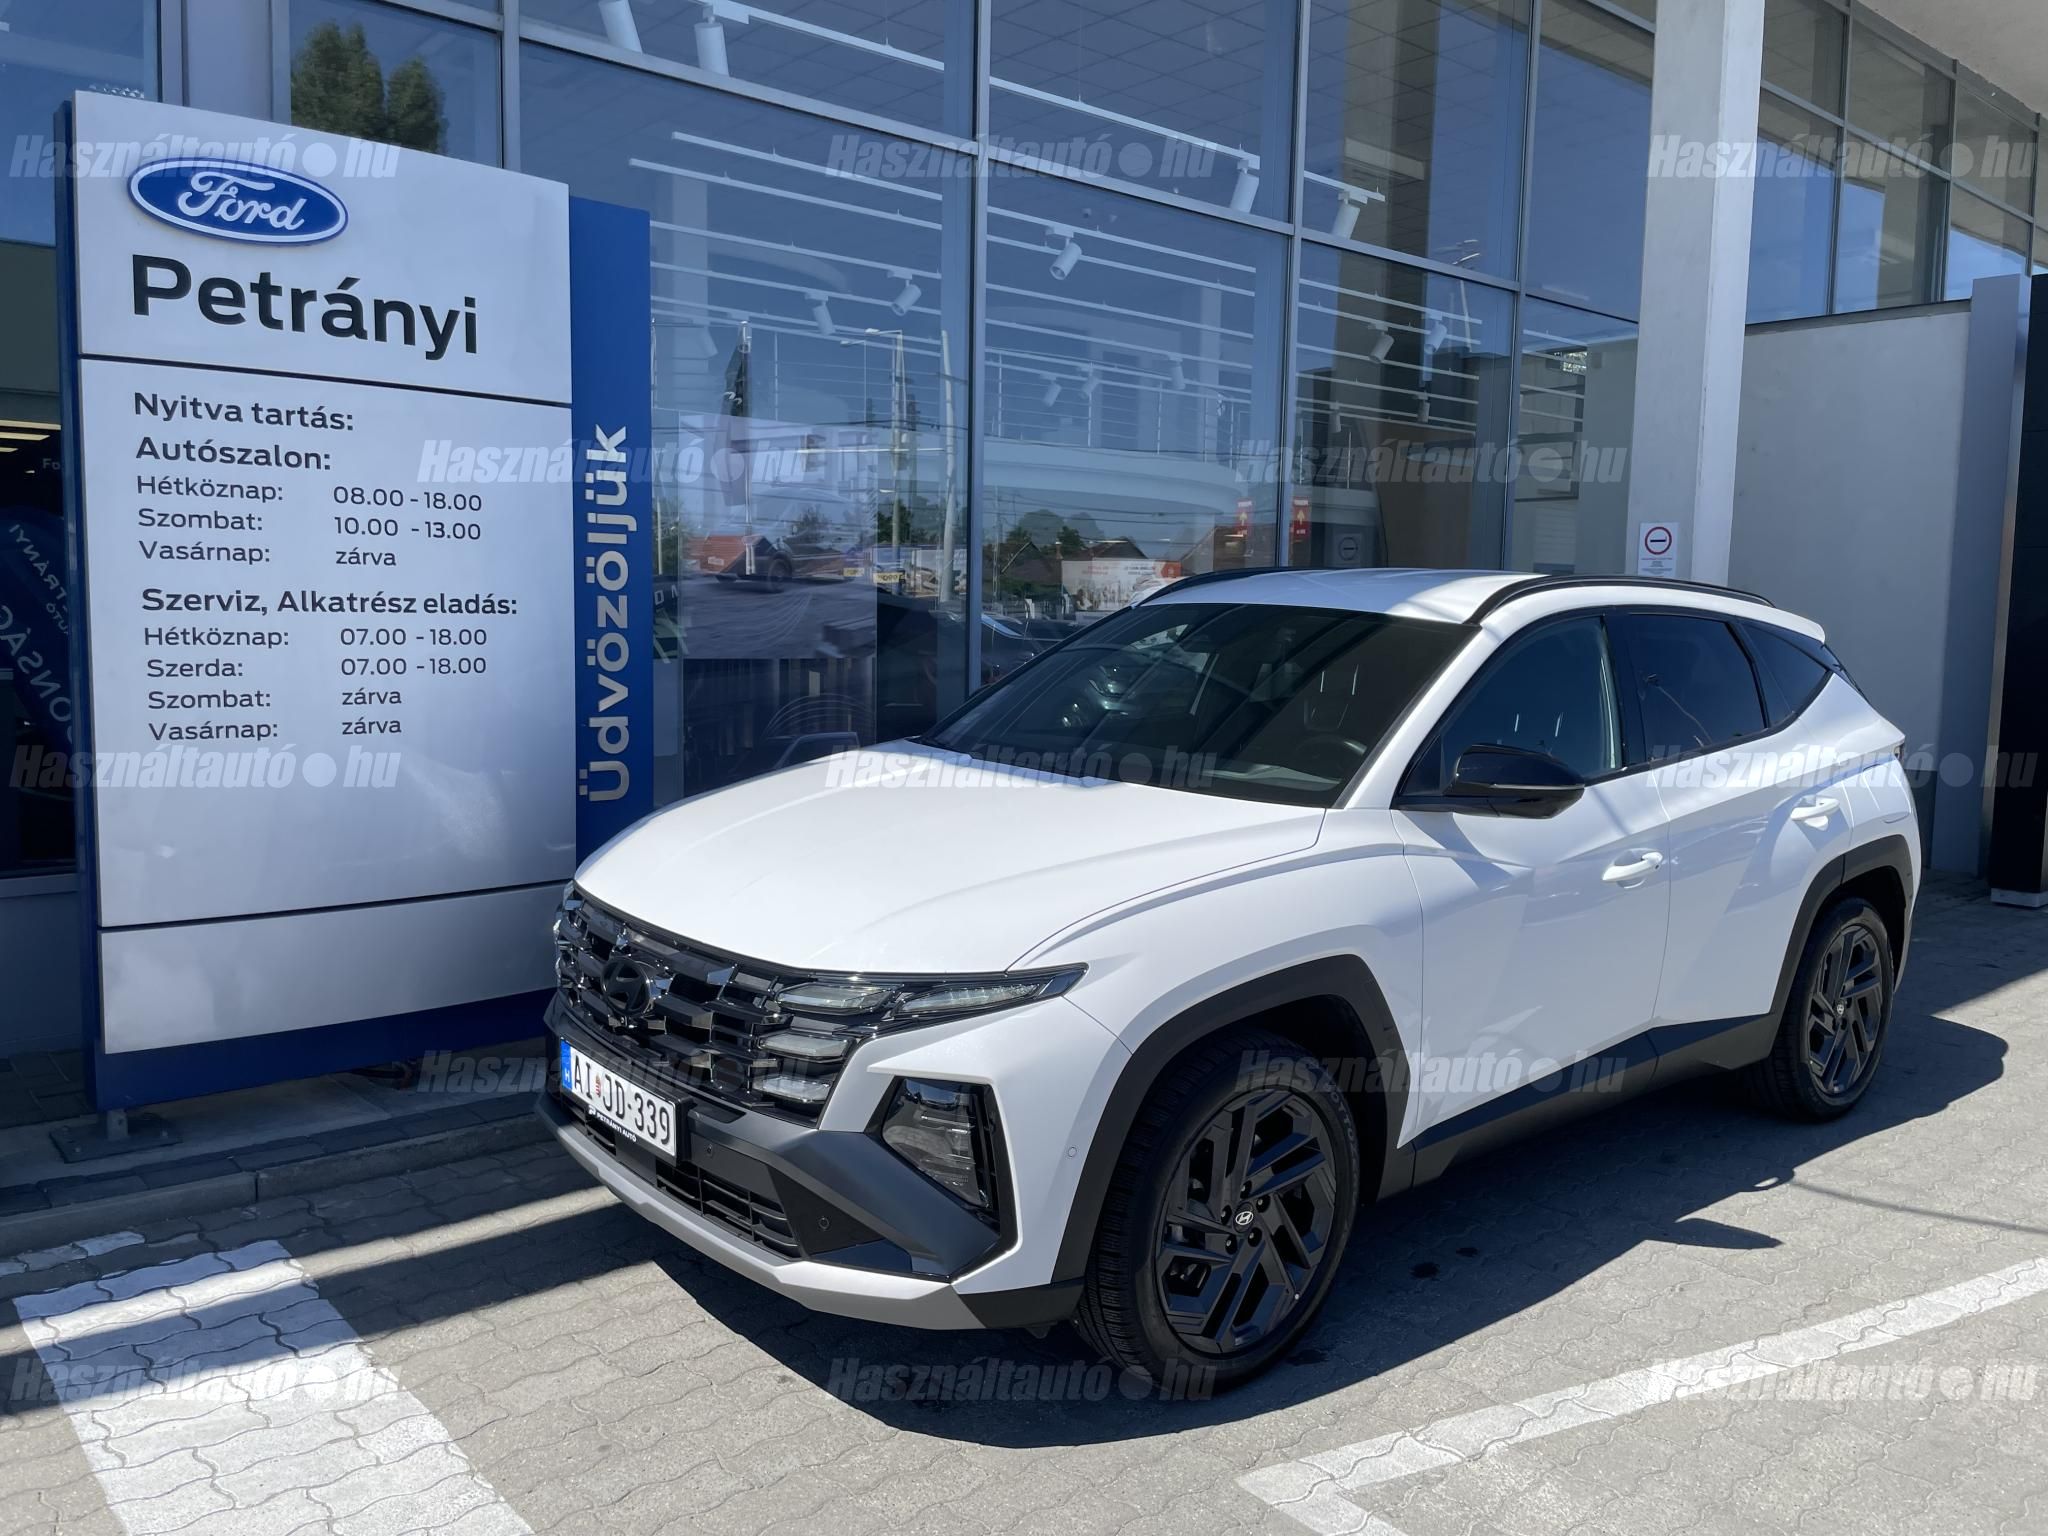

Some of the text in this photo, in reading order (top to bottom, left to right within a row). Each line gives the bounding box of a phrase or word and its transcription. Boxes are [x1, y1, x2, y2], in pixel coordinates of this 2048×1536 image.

[177, 171, 305, 231] Ford
[131, 253, 477, 361] Petrányi
[134, 391, 354, 431] Nyitva tartás:
[135, 436, 331, 471] Autószalon:
[136, 475, 283, 504] Hétköznap:
[333, 485, 404, 507] 08.00
[138, 507, 263, 531] Szombat:
[334, 516, 399, 537] 10.00
[138, 540, 397, 567] Vasárnap: zárva
[141, 588, 517, 617] Szerviz, Alkatrész eladás:
[578, 423, 637, 803] Üdvözöljük
[144, 626, 289, 649] Hétköznap:
[340, 627, 407, 646] 07.00
[146, 658, 243, 678] Szerda:
[341, 657, 407, 676] 07.00
[148, 687, 402, 710] Szombat: zárva
[148, 716, 402, 742] Vasárnap: zárva
